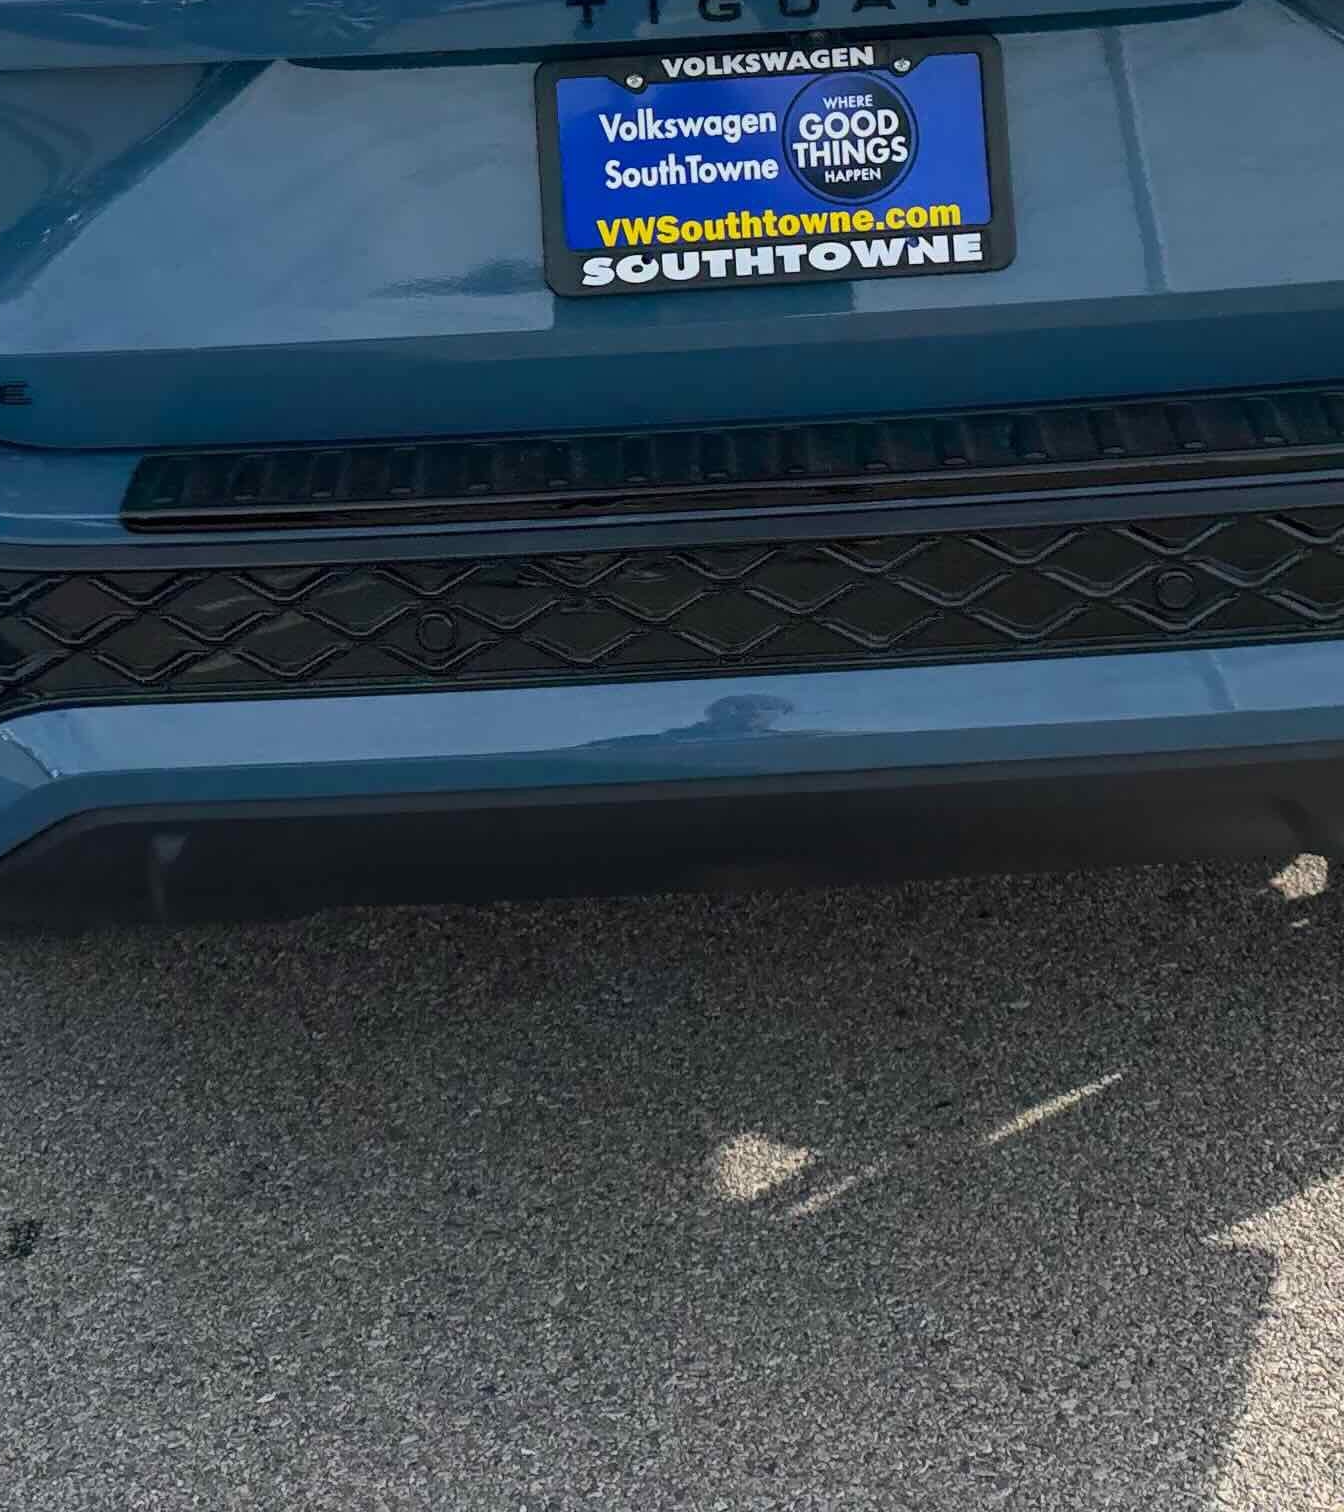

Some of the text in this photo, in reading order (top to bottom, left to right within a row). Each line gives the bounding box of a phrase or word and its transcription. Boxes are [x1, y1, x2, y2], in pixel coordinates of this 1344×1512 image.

[661, 46, 875, 79] VOLKSWAGEN
[822, 94, 874, 109] WHERE
[599, 107, 777, 146] Volkswagen
[799, 108, 899, 142] GOOD
[792, 135, 909, 169] THINGS
[604, 153, 779, 190] SouthTowne
[824, 166, 882, 185] HAPPEN
[596, 202, 961, 248] VWSouthtowne.com
[581, 232, 984, 287] SOUTHTOWNE
